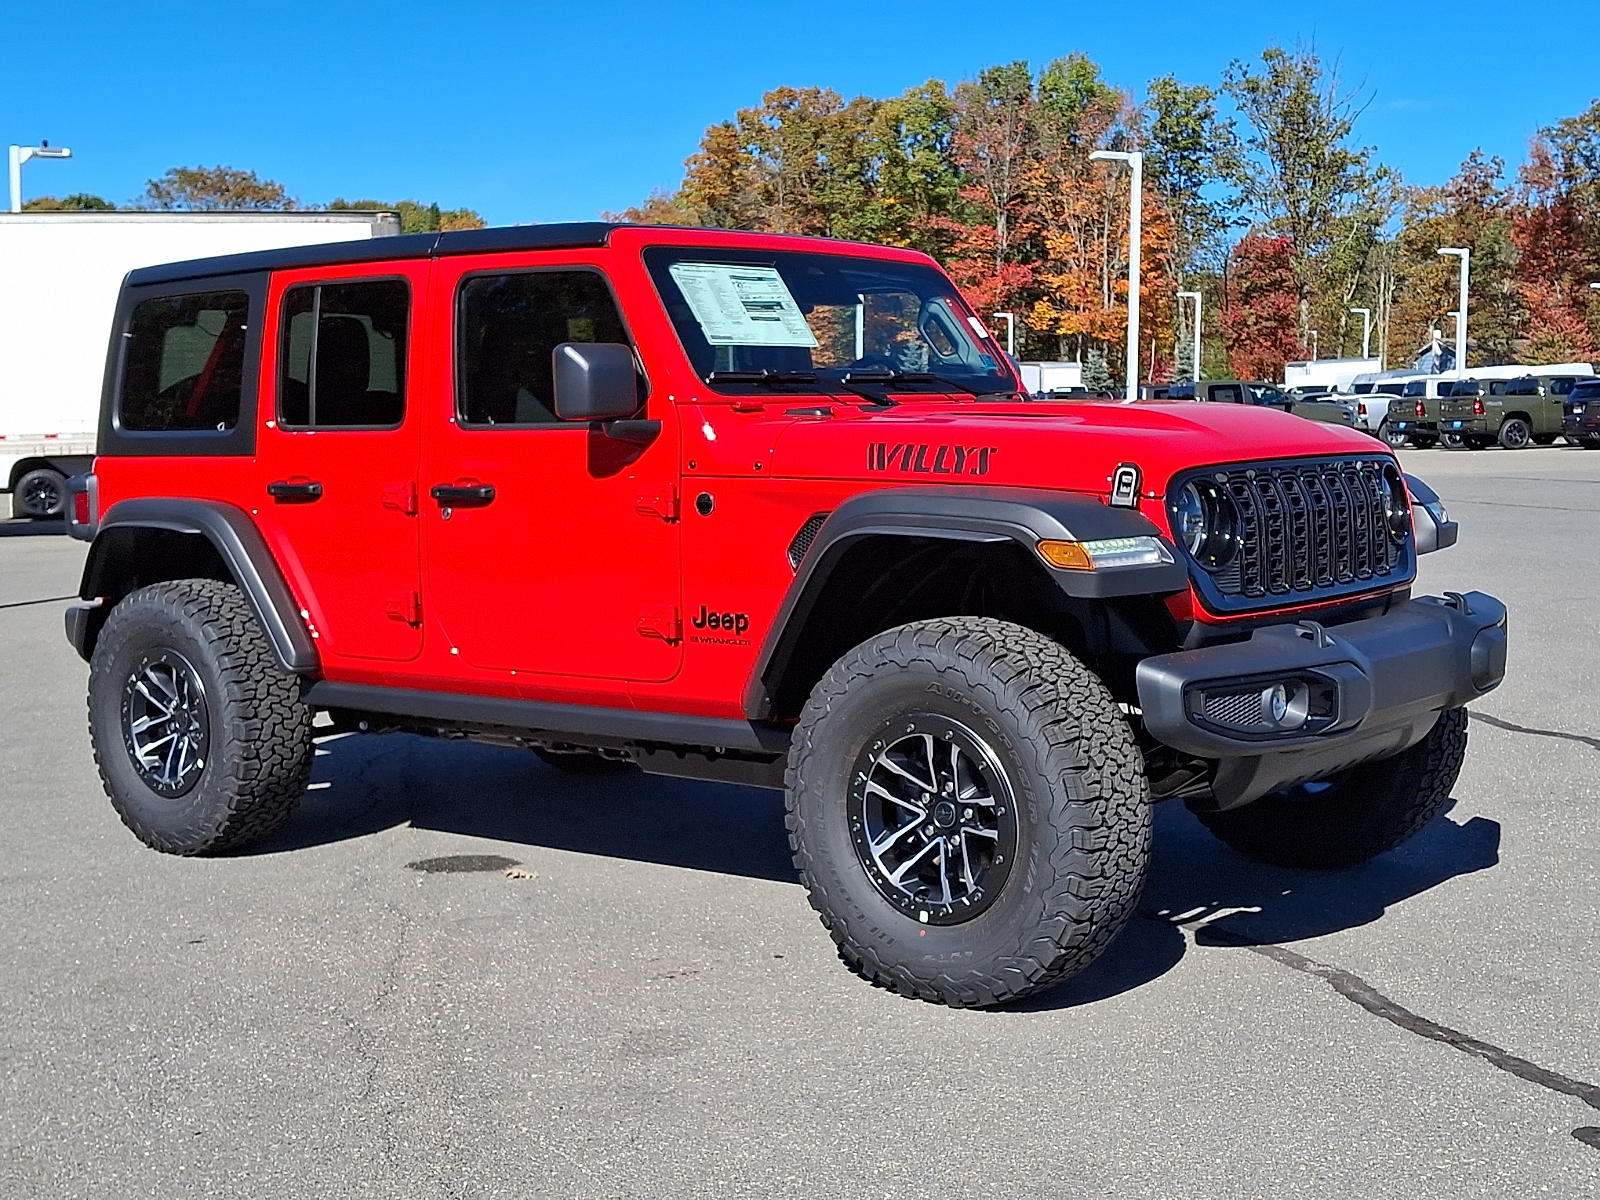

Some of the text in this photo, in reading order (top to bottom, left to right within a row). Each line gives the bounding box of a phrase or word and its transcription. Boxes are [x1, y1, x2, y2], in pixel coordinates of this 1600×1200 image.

[868, 443, 998, 475] WILLYS
[692, 605, 749, 636] Jeep
[698, 636, 752, 646] WRANGLER
